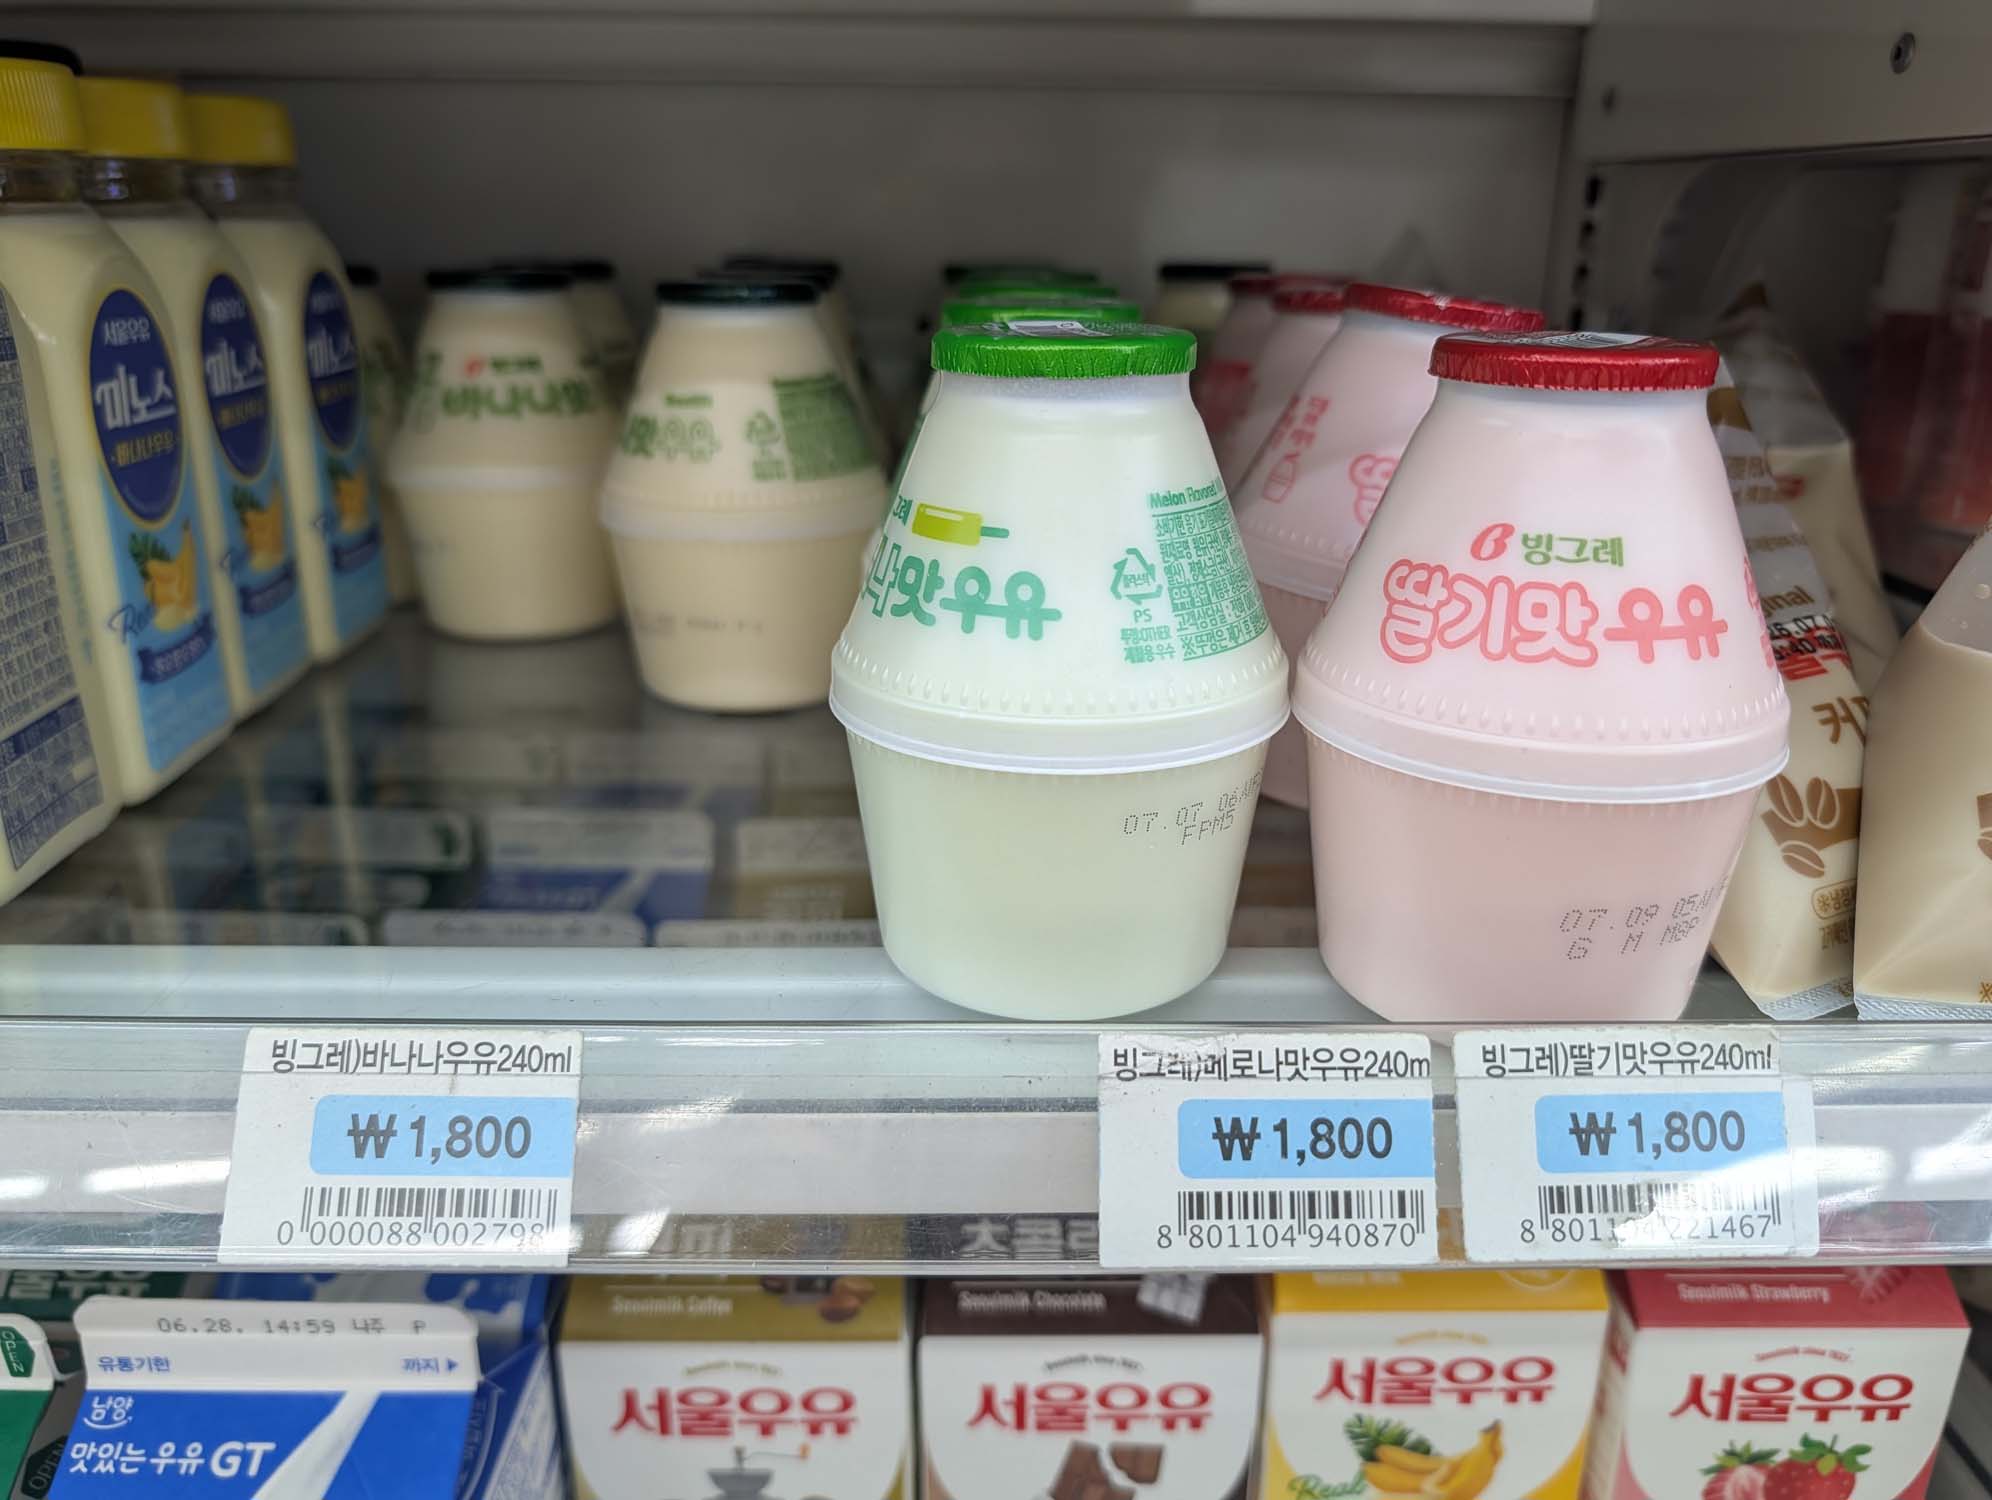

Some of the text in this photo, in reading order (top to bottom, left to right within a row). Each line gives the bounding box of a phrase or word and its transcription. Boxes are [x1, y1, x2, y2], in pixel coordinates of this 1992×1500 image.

[95, 363, 177, 430] 미노스
[1149, 491, 1187, 508] Melon
[1521, 533, 1625, 567] 빙그레
[1133, 607, 1152, 621] PS
[1380, 558, 1728, 668] 딸기맛우유
[271, 1038, 572, 1076] 빙그레)바나나우유240ml
[1482, 1040, 1772, 1077] 빙그레)딸기맛우유240ml
[1188, 1224, 1297, 1248] 801104
[1307, 1223, 1416, 1248] 940870
[1677, 1283, 1830, 1304] Seoulmilk Strawberry
[156, 1317, 245, 1335] 06.28.
[263, 1317, 337, 1335] 14:59
[1, 1330, 26, 1374] OPEN
[97, 1354, 440, 1375] 유통기한 까지
[1314, 1354, 1557, 1405] 서울우유
[1668, 1371, 1914, 1423] 서울우유
[89, 1395, 134, 1424] 남양
[612, 1385, 859, 1438] 서울우유
[967, 1381, 1214, 1434] 서울우유
